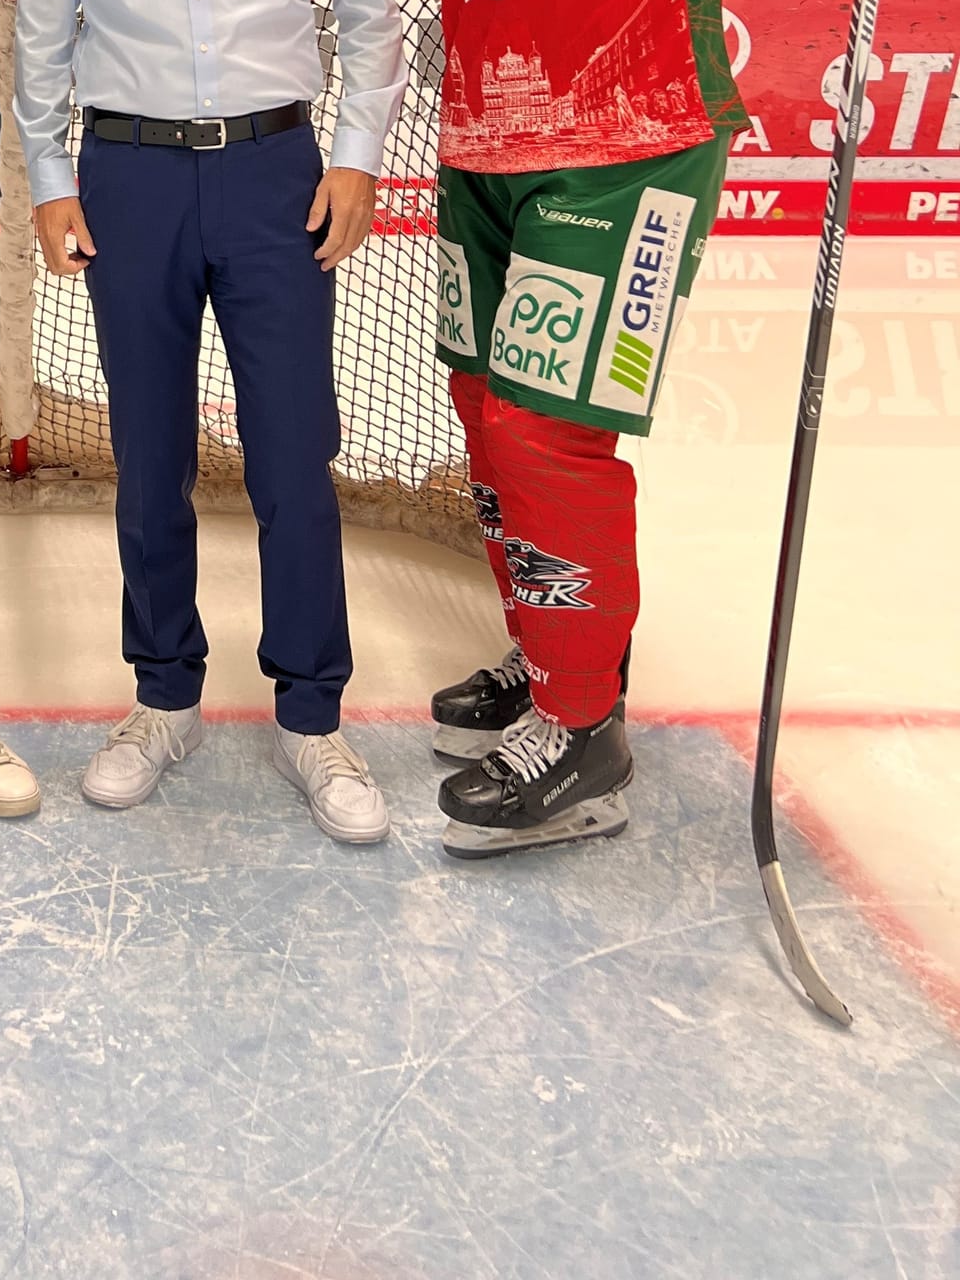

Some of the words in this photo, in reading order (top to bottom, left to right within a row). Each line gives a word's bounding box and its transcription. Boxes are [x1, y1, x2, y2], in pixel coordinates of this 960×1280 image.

[546, 209, 614, 231] BAUER
[622, 209, 668, 332] GREIF
[509, 292, 584, 344] psd
[494, 327, 571, 386] Bank
[542, 770, 580, 808] BAUER
